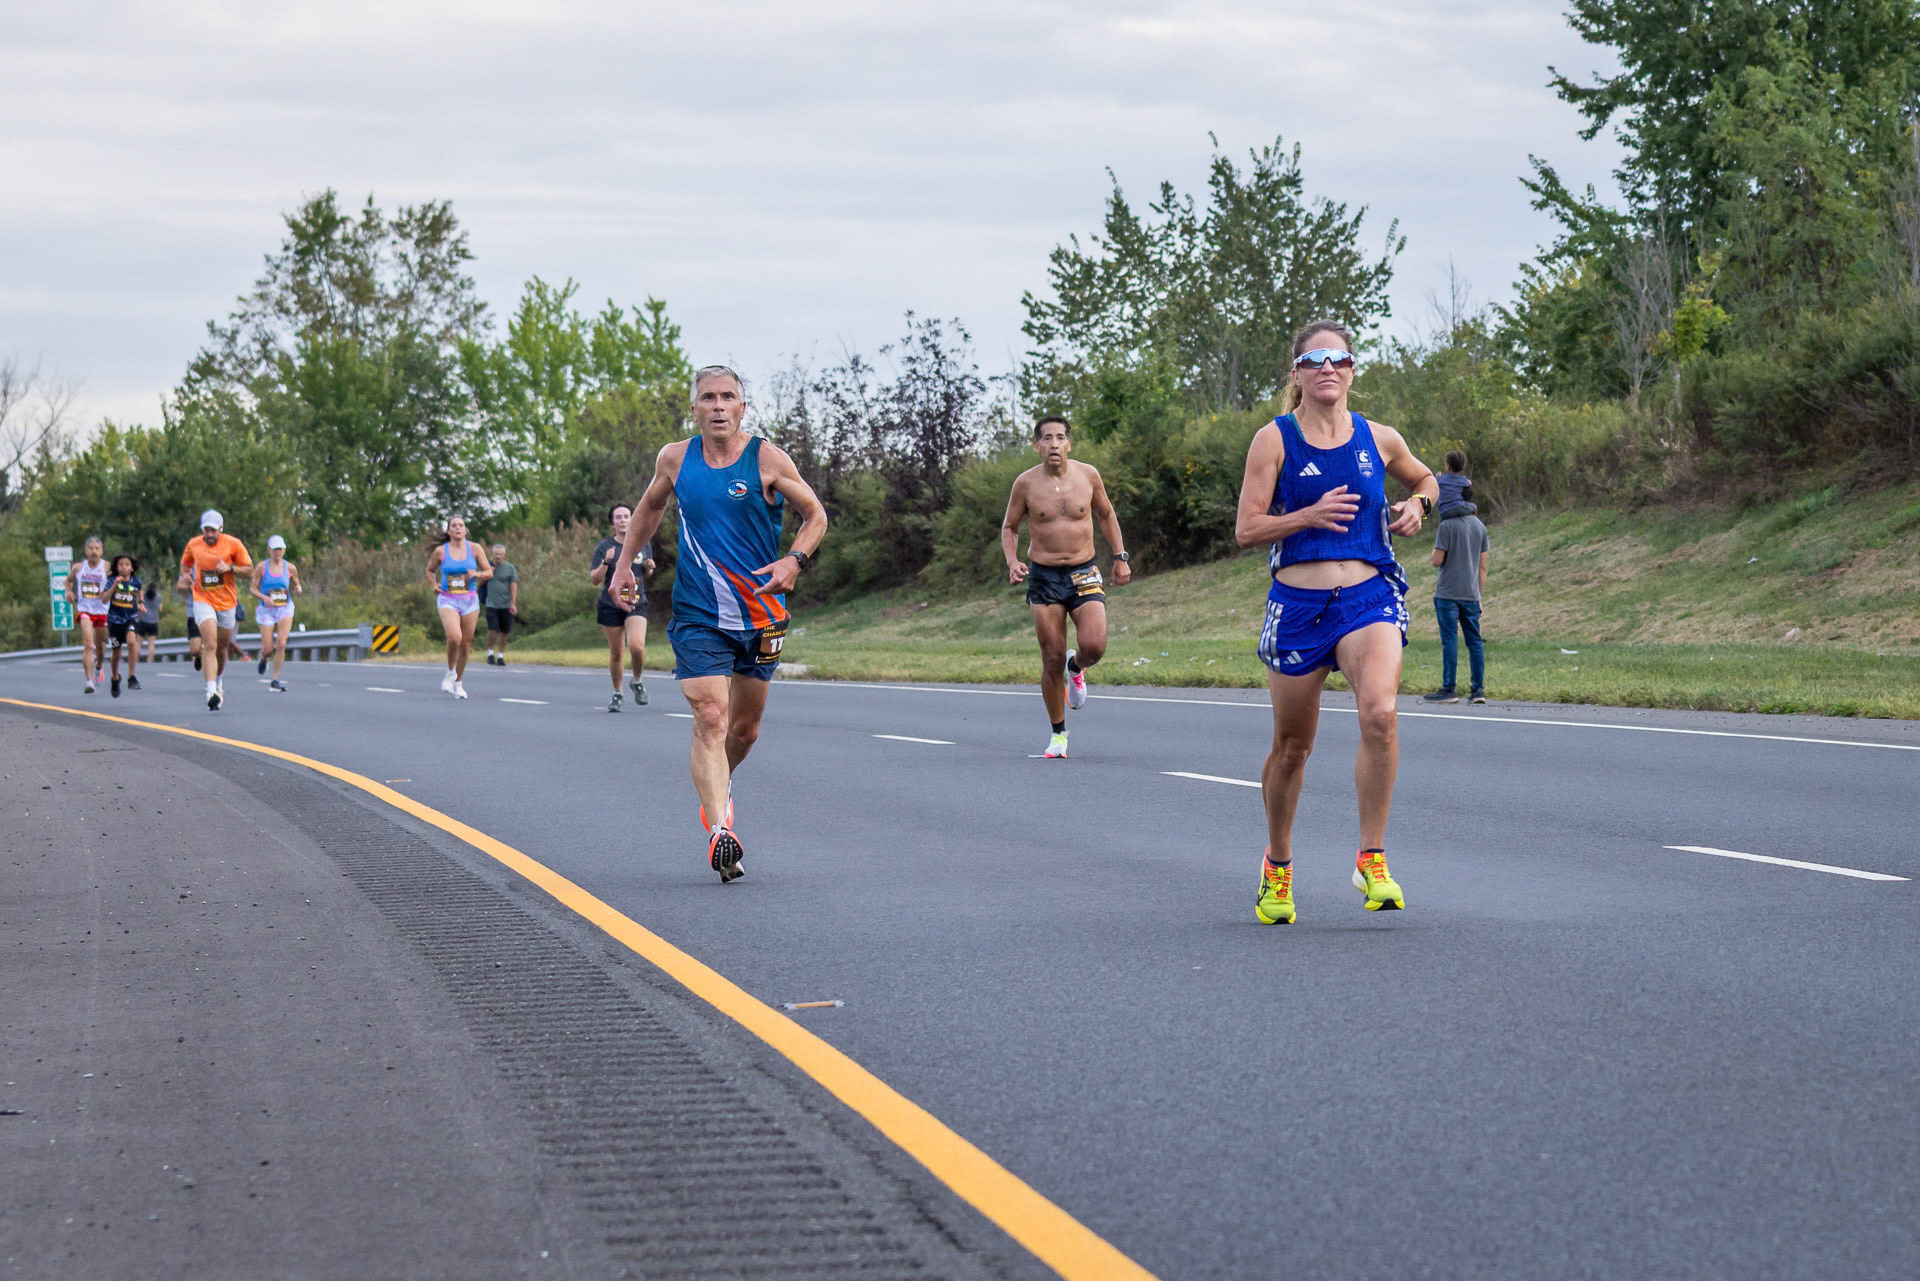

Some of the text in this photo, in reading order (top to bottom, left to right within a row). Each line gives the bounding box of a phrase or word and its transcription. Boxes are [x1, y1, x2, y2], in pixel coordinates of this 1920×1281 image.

[53, 565, 69, 573] SOUTH
[59, 602, 66, 613] 2
[61, 616, 68, 627] 4
